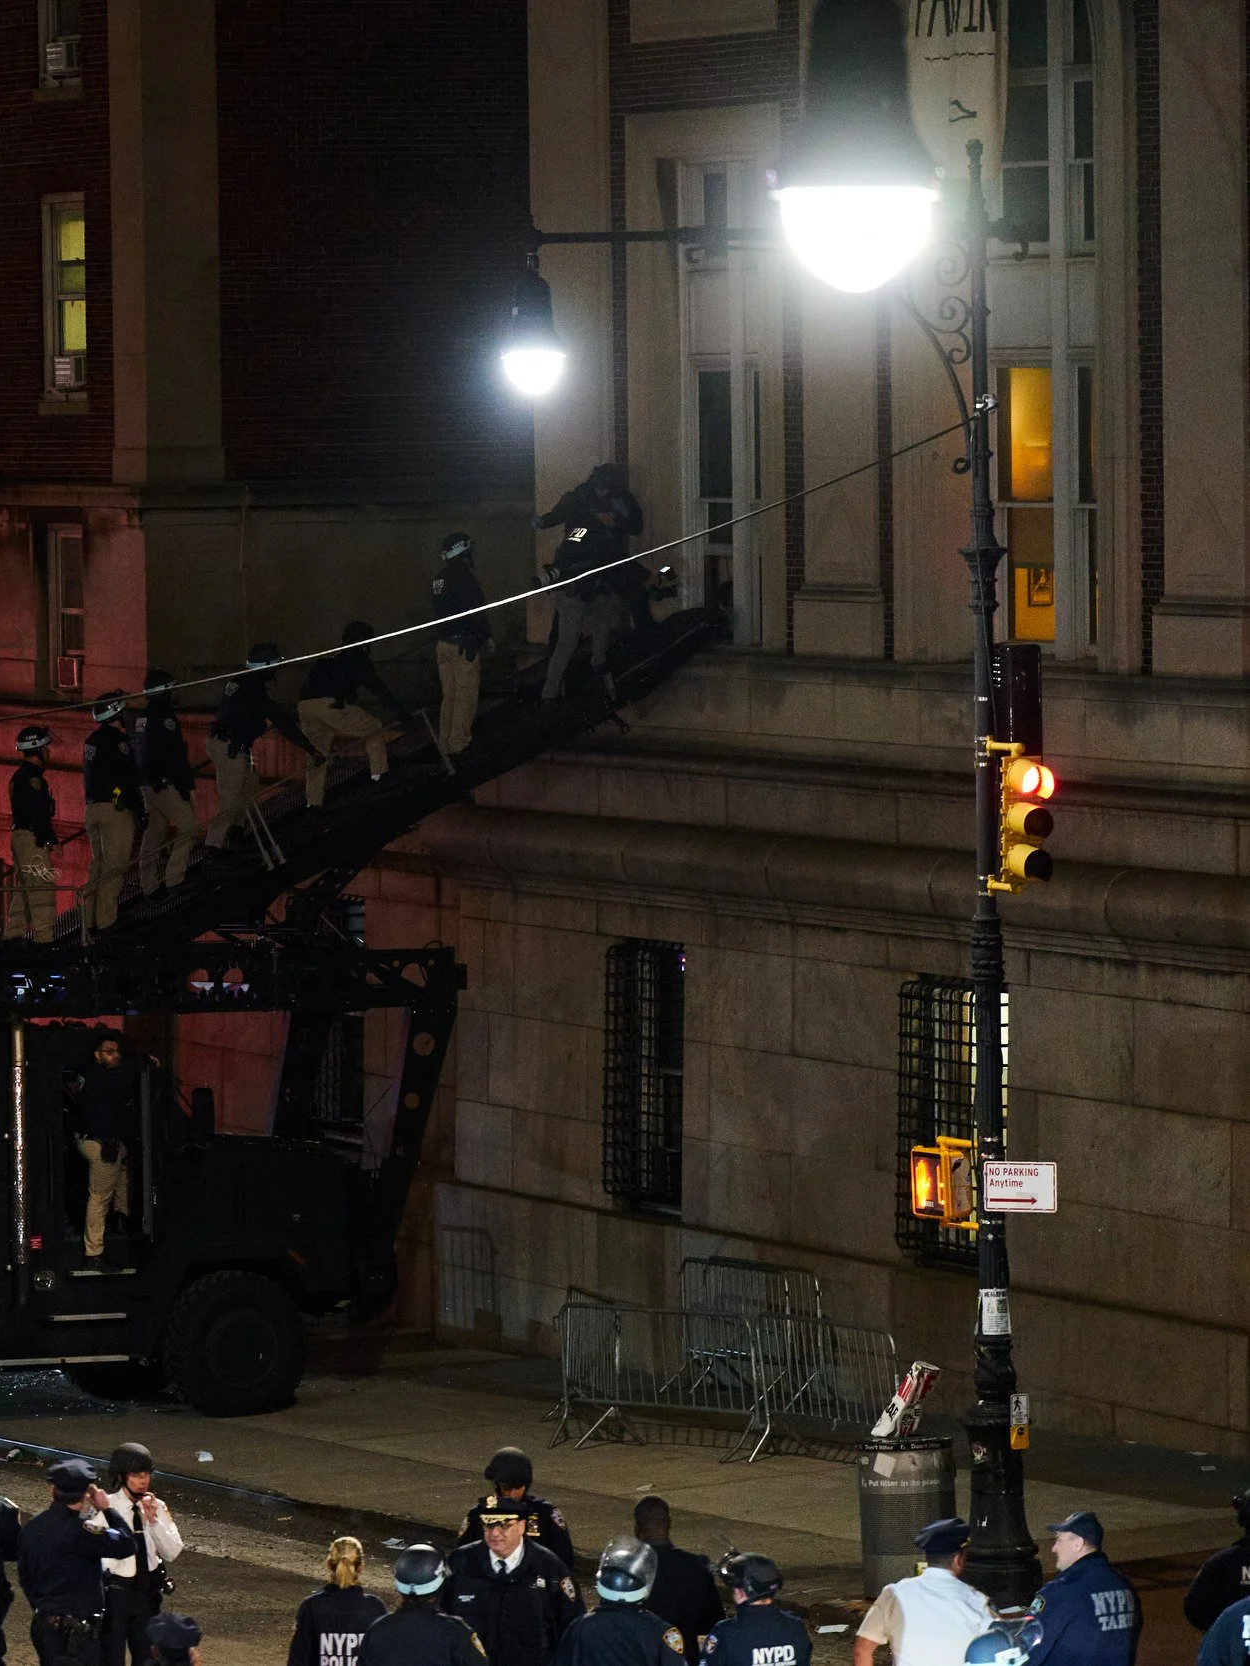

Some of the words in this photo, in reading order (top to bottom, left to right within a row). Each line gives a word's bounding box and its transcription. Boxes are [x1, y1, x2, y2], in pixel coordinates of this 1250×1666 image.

[989, 1167, 1000, 1176] NO
[1003, 1167, 1039, 1177] PARKING
[990, 1179, 1024, 1188] Anytime
[1091, 1590, 1134, 1616] NYPD
[752, 1644, 795, 1666] NYPD
